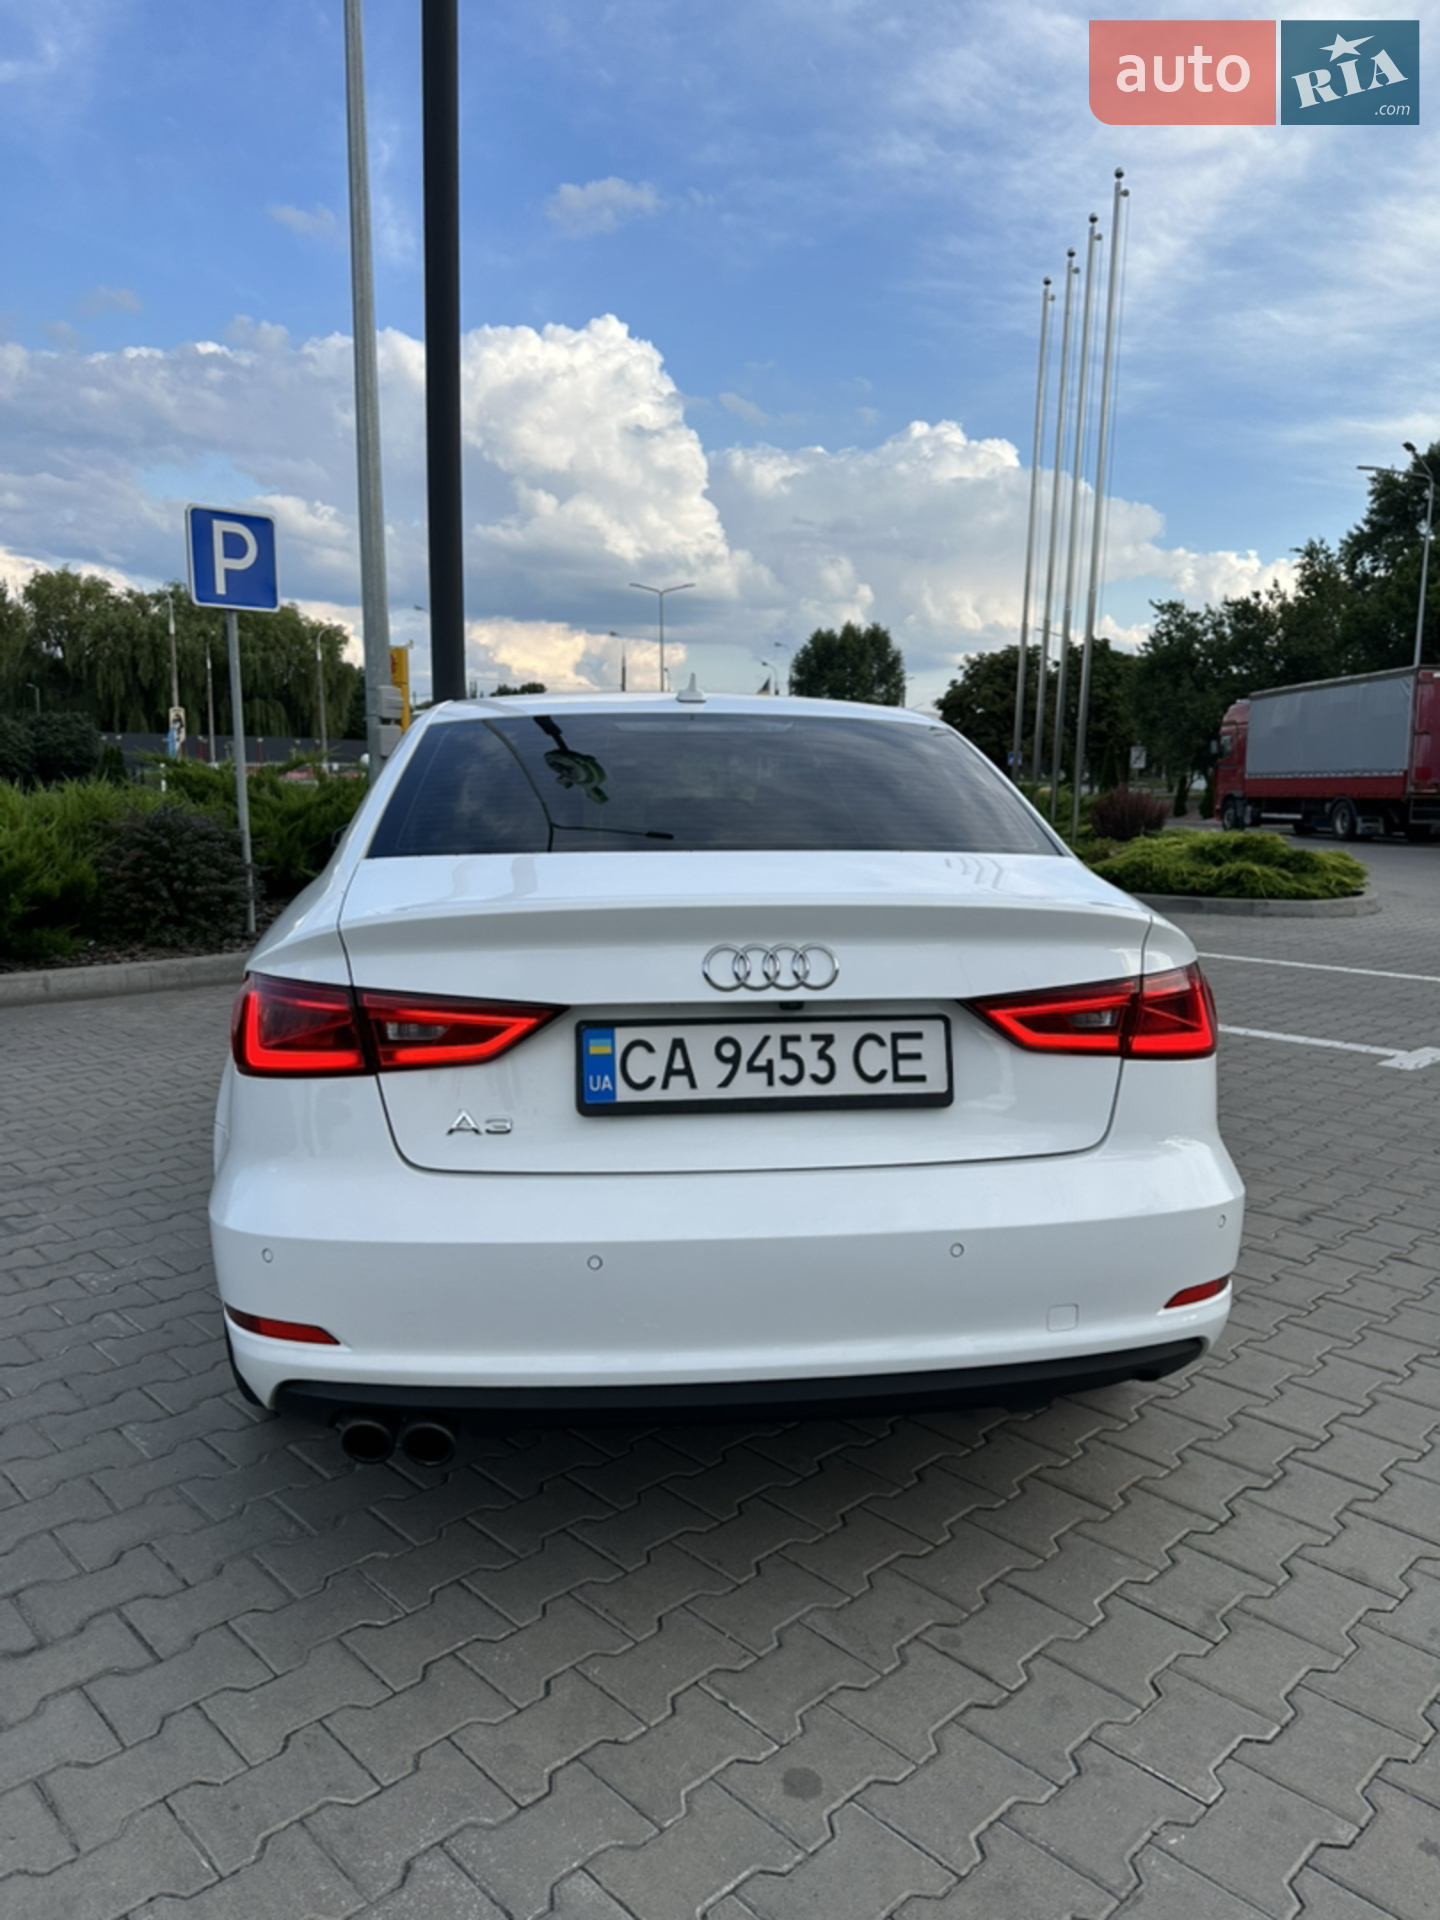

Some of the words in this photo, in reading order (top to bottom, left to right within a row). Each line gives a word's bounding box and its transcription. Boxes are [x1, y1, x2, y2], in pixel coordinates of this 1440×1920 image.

[212, 518, 258, 595] P
[588, 1074, 613, 1092] UA
[619, 1037, 698, 1092] CA
[713, 1032, 837, 1089] 9453
[852, 1031, 928, 1084] CE
[446, 1108, 514, 1136] A3
